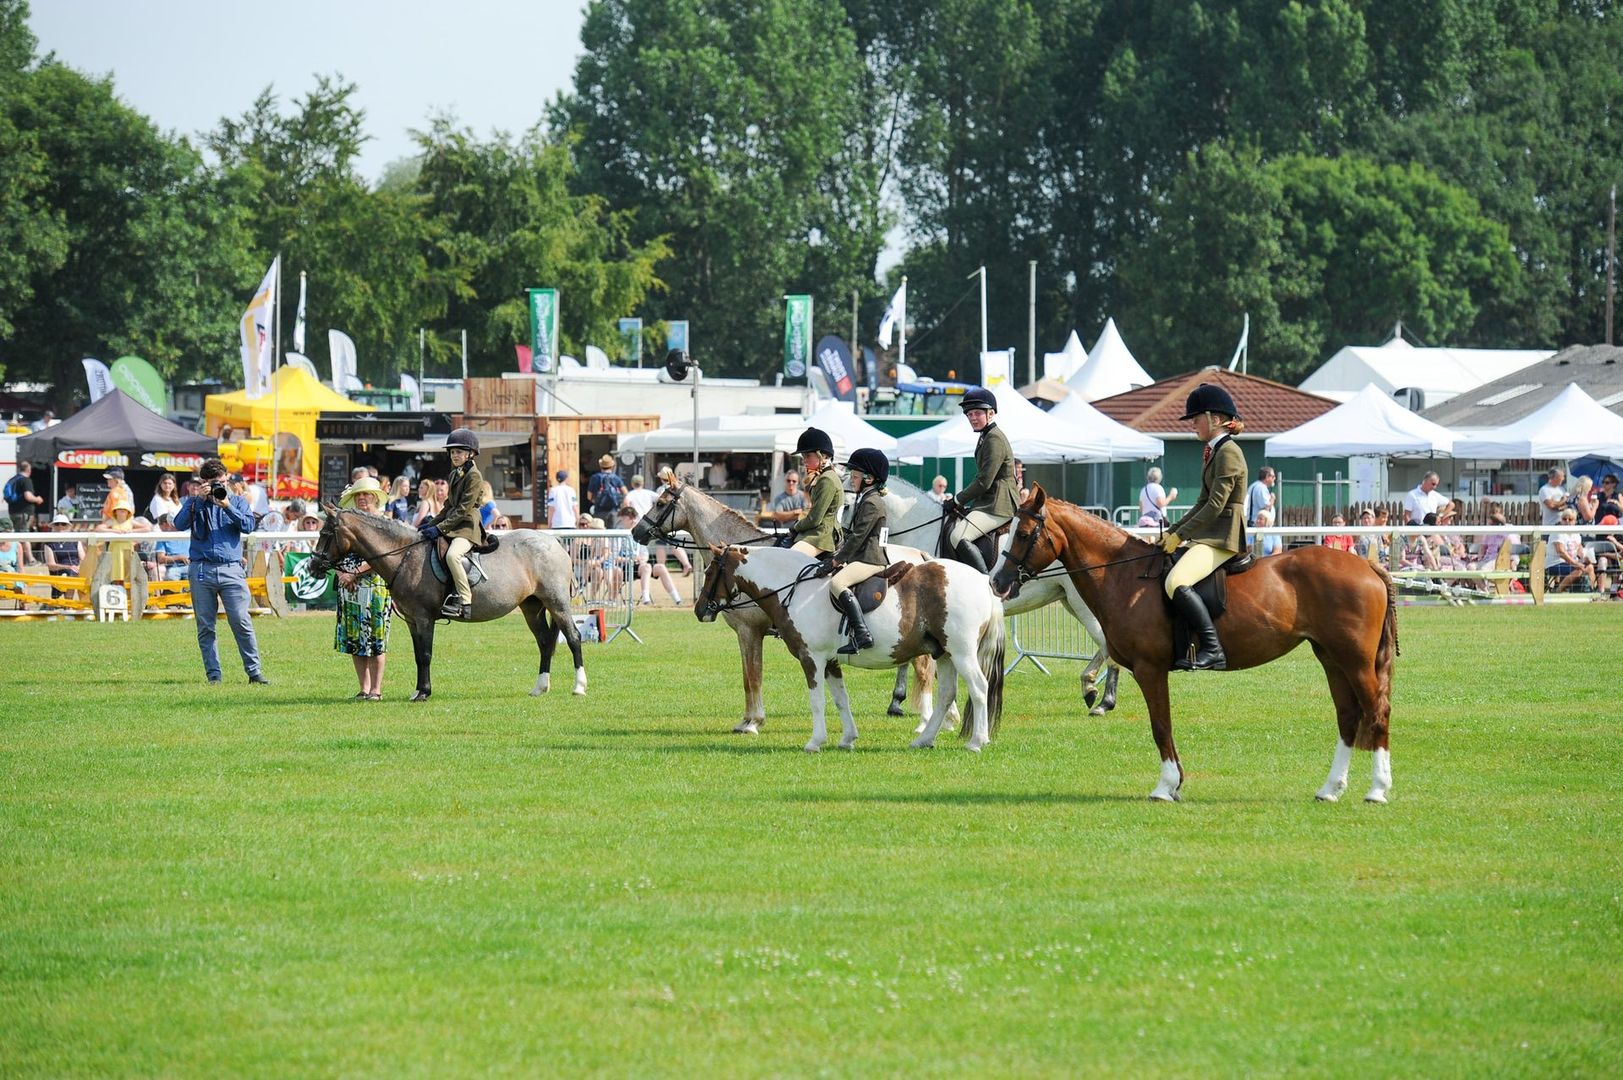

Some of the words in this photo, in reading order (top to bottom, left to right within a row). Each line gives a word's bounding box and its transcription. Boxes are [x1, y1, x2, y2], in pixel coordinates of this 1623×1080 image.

[58, 450, 129, 467] German
[140, 452, 211, 468] Sausag
[106, 590, 121, 606] 6
